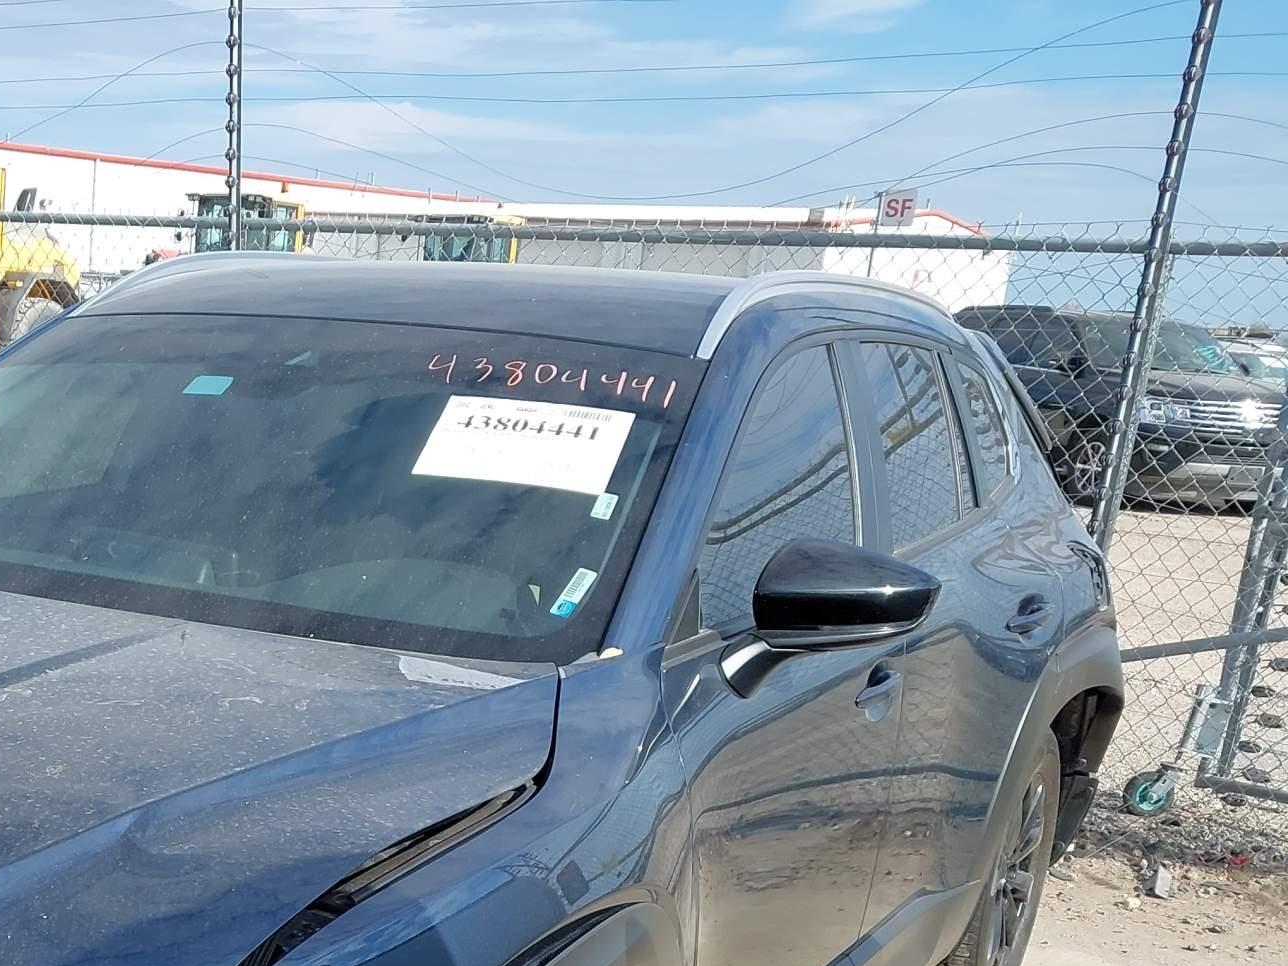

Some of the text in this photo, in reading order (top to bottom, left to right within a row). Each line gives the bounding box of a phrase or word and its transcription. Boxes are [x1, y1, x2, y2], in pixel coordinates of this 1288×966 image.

[885, 198, 914, 218] SF
[428, 353, 677, 409] 43804441
[457, 415, 599, 440] 43804441
